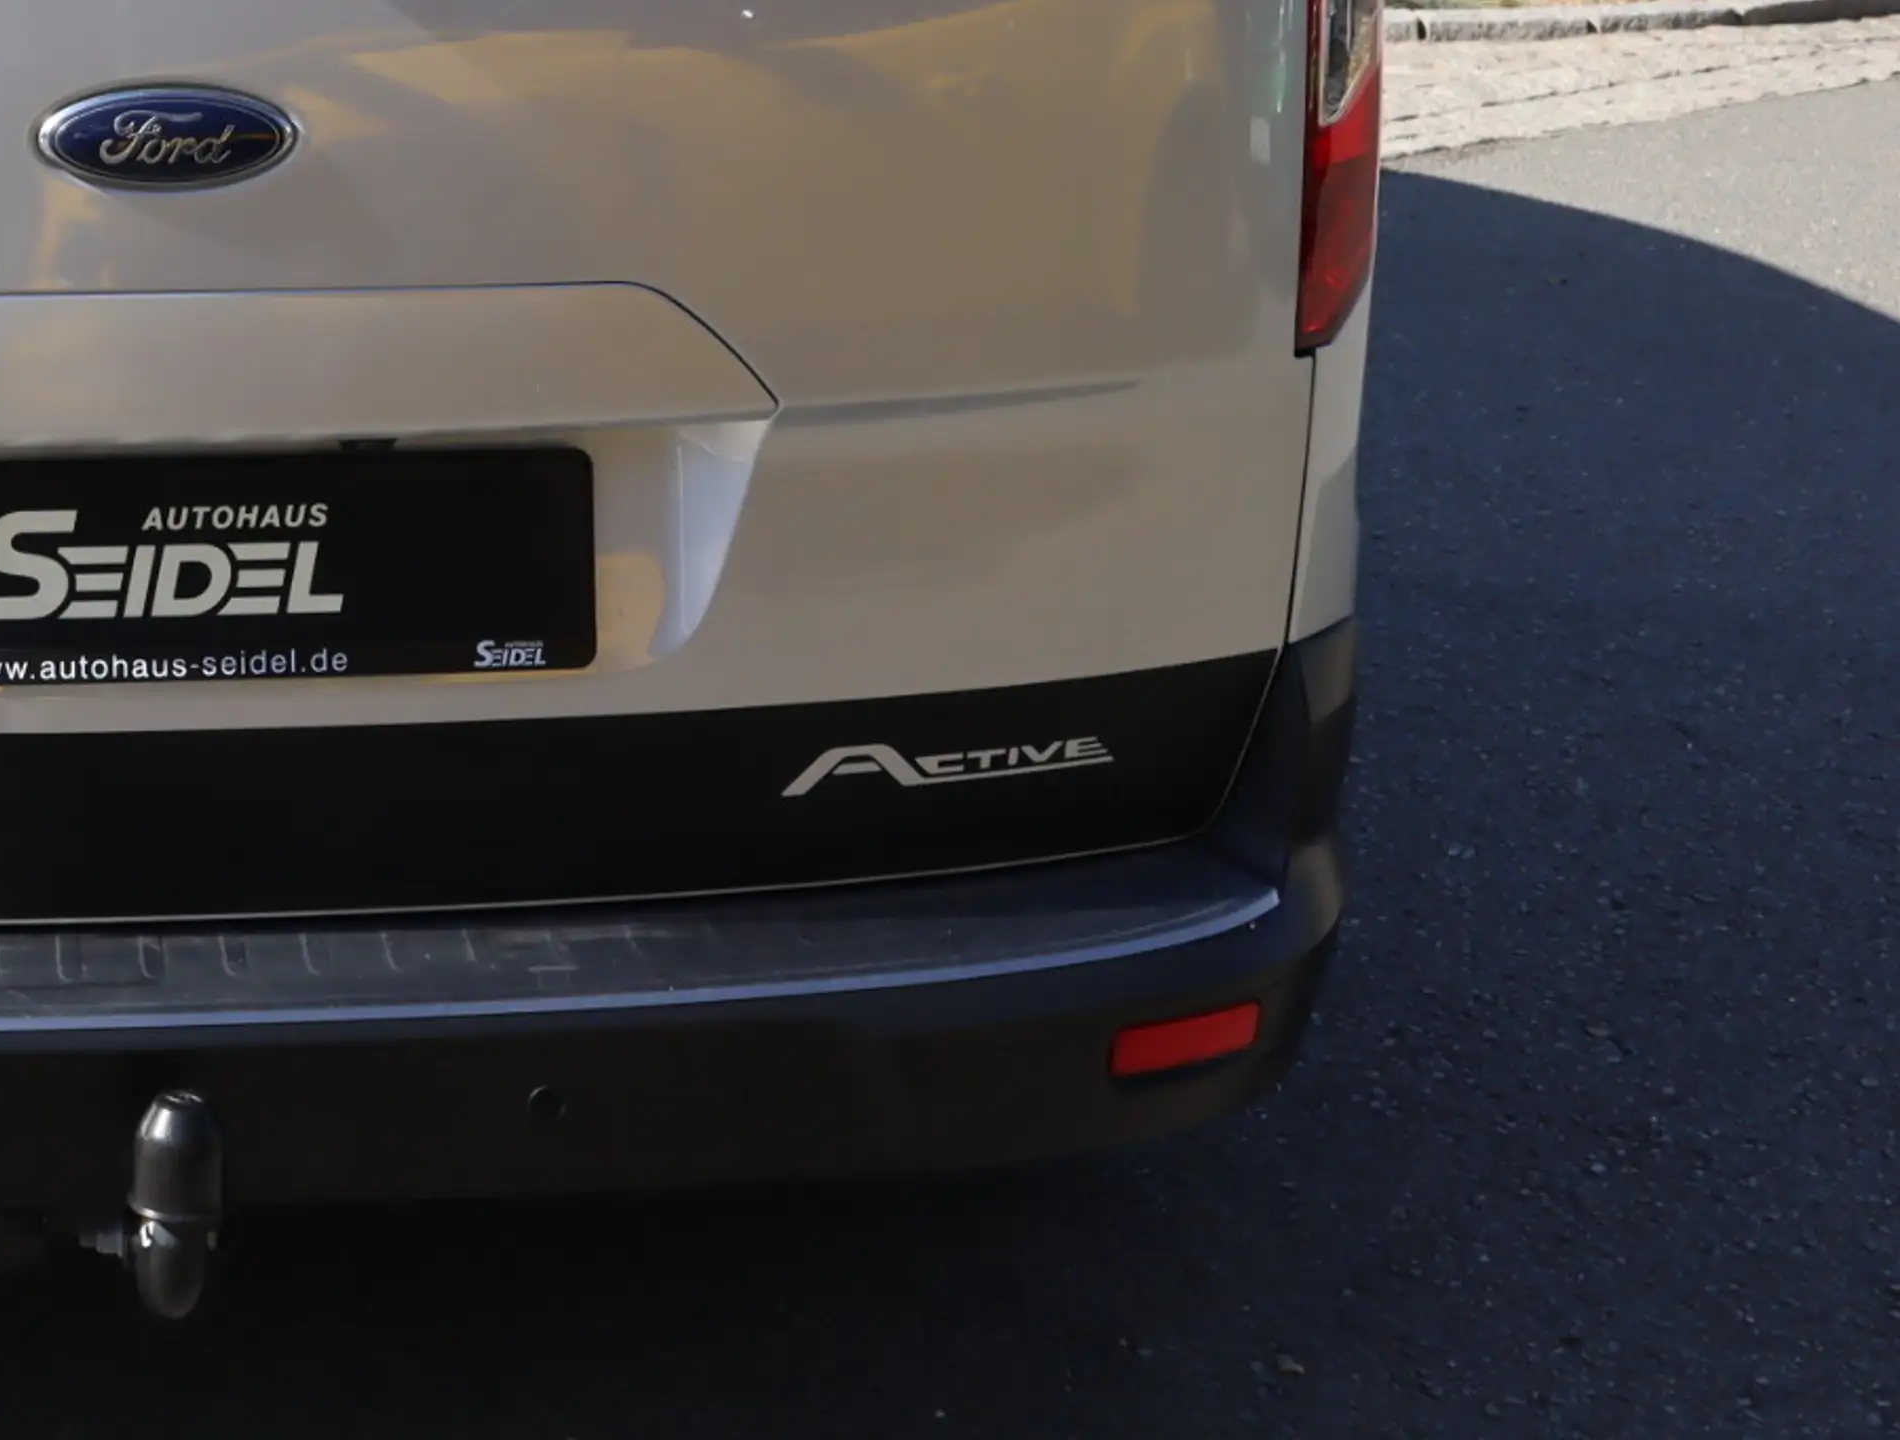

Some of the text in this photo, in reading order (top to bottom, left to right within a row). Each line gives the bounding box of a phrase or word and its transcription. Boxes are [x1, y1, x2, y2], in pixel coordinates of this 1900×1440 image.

[100, 110, 236, 164] Ford
[142, 503, 329, 531] AUTOHAUS
[474, 640, 546, 668] SEIDEL
[781, 736, 1113, 797] ACTIVE
